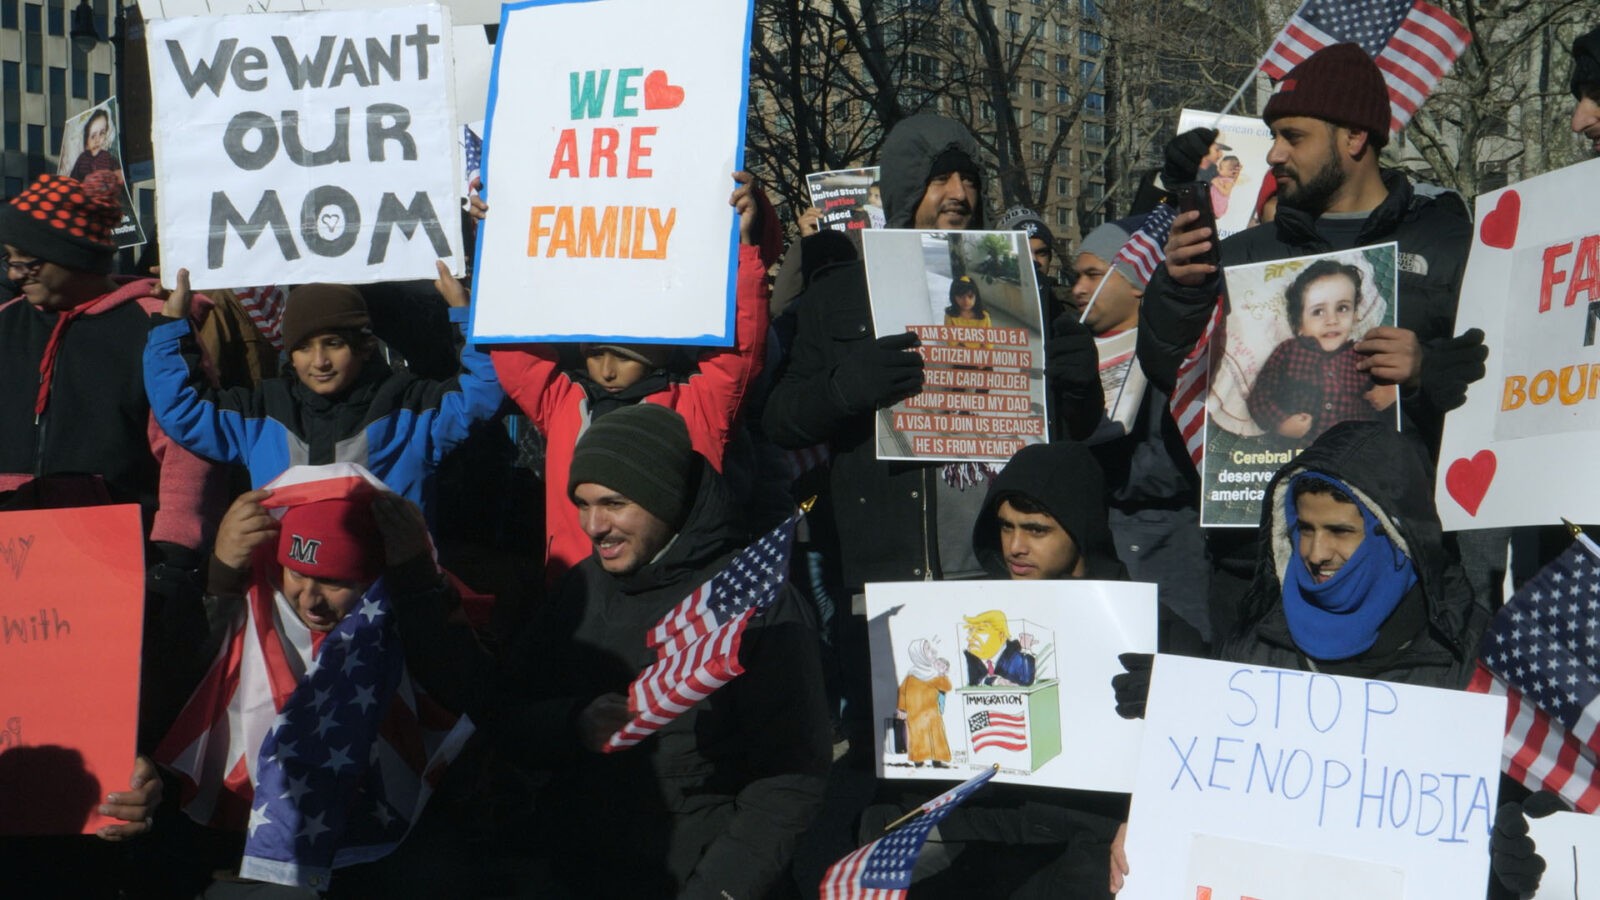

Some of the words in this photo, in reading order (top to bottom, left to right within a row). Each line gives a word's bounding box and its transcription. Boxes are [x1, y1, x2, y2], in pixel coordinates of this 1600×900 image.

[165, 38, 268, 98] We
[569, 67, 644, 120] WE
[223, 103, 418, 170] OUR
[549, 126, 659, 179] ARE
[208, 185, 452, 269] MOM
[527, 205, 676, 259] FAMILY
[922, 328, 939, 340] AM
[941, 327, 949, 340] 3
[950, 328, 985, 342] YEARS
[987, 329, 1007, 343] OLD
[1010, 331, 1017, 344] &
[1019, 331, 1027, 345] A
[931, 348, 971, 363] CITIZEN
[973, 350, 989, 365] MY
[992, 351, 1017, 366] MOM
[1020, 353, 1030, 367] IS
[956, 372, 984, 387] CARD
[987, 374, 1027, 389] HOLDER
[947, 394, 985, 410] DENIED
[988, 396, 1004, 410] MY
[1007, 397, 1028, 411] DAD
[897, 415, 904, 429] A
[906, 415, 932, 430] VISA
[934, 416, 948, 431] TO
[950, 417, 973, 432] JOIN
[976, 418, 990, 432] US
[992, 419, 1041, 434] BECAUSE
[916, 438, 931, 453] HE
[933, 439, 944, 453] IS
[946, 439, 977, 454] FROM
[1233, 450, 1292, 464] Cerebral
[1218, 470, 1275, 483] deserve
[288, 534, 322, 565] M
[966, 694, 1023, 705] IMMIGRATION
[1227, 669, 1399, 755] STOP
[1168, 736, 1492, 843] XENOPHOBIA
